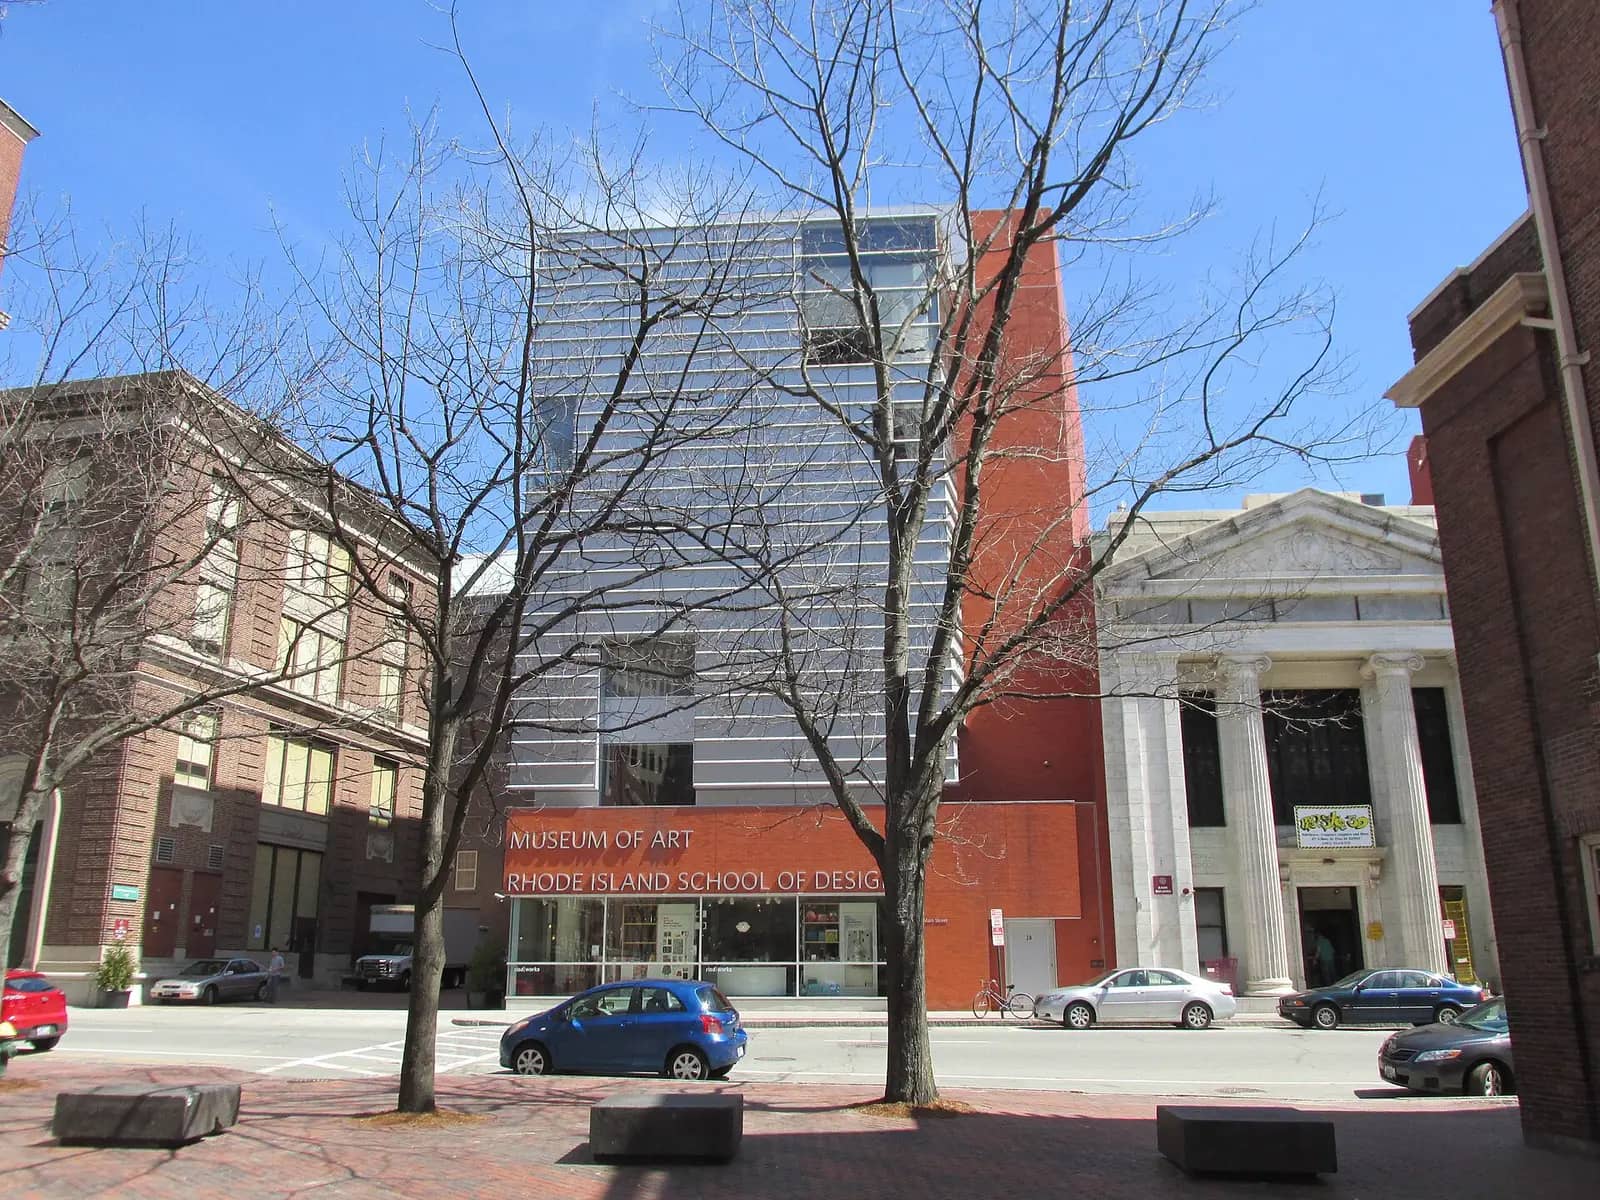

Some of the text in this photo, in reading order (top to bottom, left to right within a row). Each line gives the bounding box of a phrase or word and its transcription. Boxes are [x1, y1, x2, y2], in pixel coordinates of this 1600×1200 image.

[509, 829, 695, 850] MUSEUM OF ART
[507, 870, 886, 892] RHODE ISLAND SCHOOL OF DESIG
